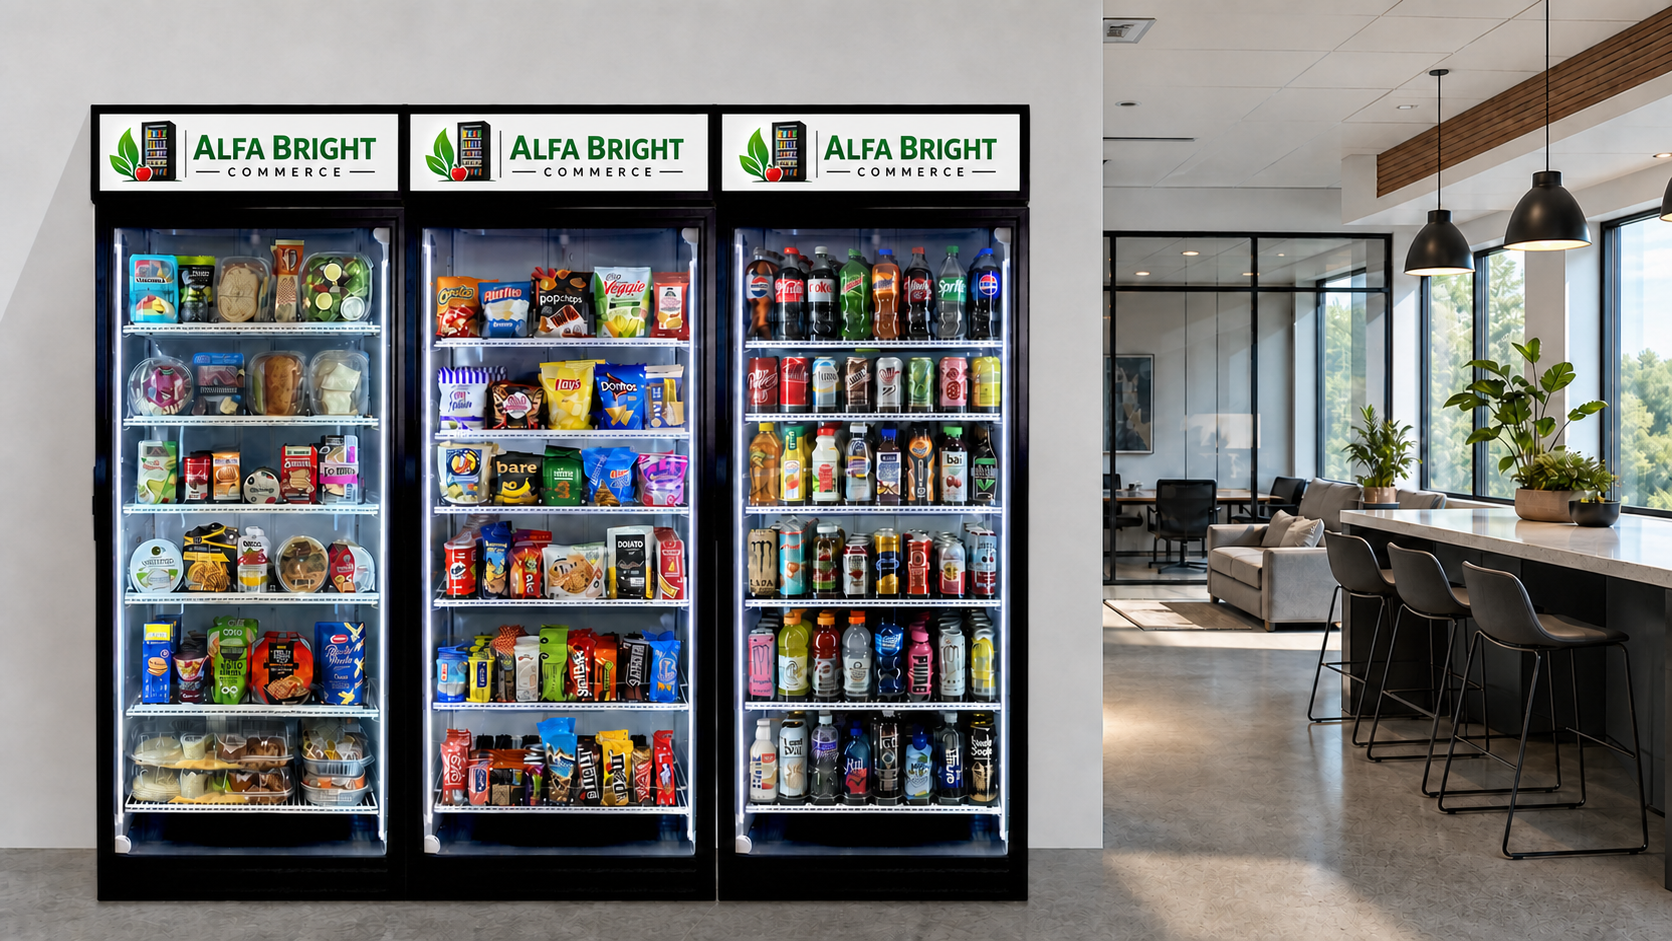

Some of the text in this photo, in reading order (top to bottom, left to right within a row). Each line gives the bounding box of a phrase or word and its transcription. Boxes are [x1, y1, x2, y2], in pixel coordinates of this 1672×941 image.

[193, 135, 376, 160] ALFA BRIGHT
[510, 135, 684, 160] ALFA BRIGHT
[824, 135, 997, 160] ALFA BRIGHT
[228, 167, 340, 177] COMMERCE
[544, 167, 651, 177] COMMERCE
[858, 167, 964, 177] COMMERCE
[604, 280, 646, 297] Veggie
[947, 454, 963, 464] bai
[496, 461, 538, 474] bare
